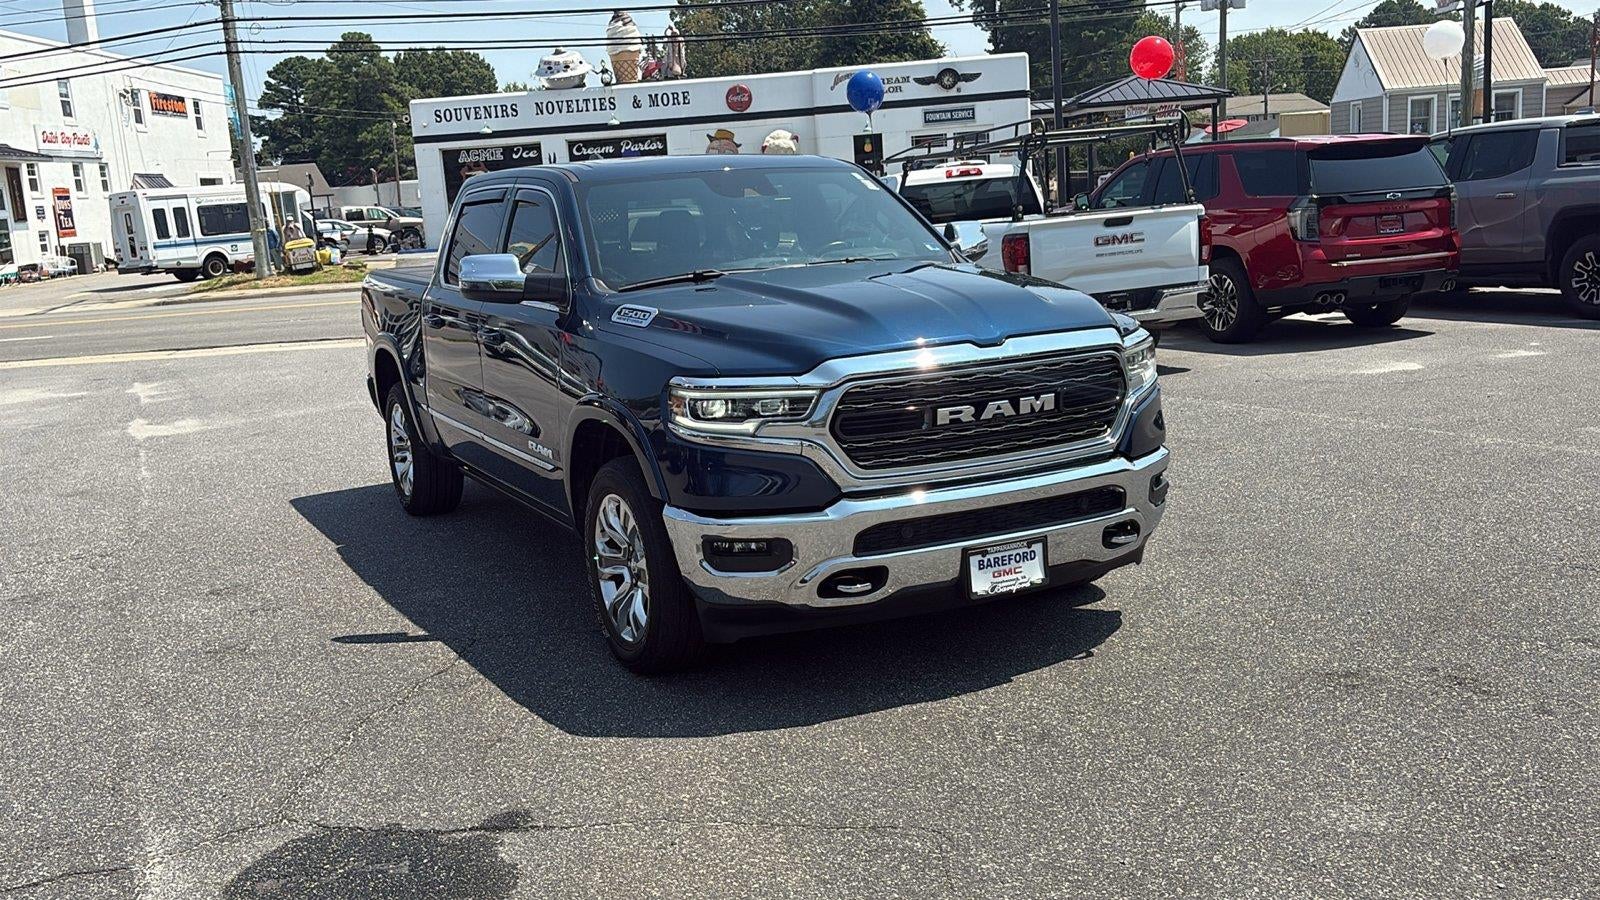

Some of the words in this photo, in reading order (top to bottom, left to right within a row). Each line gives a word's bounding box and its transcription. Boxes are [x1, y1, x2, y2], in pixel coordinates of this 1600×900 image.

[434, 103, 519, 123] SOUVENIRS
[535, 96, 617, 116] NOVELTIES
[632, 95, 642, 109] &
[648, 91, 691, 108] MORE
[925, 112, 951, 121] FOUNTAIN
[952, 110, 974, 119] SERVICE
[42, 130, 58, 144] Dutch
[60, 131, 71, 148] Boy
[73, 132, 90, 146] Paints
[572, 142, 615, 156] Cream
[620, 139, 664, 153] Parlor
[458, 148, 503, 163] ACME
[512, 146, 539, 159] Ice
[1094, 232, 1145, 246] GMC
[619, 308, 651, 319] 1500
[937, 393, 1055, 425] RAM
[528, 440, 553, 459] RAM
[978, 549, 1036, 571] BAREFORD
[992, 566, 1023, 578] GMC
